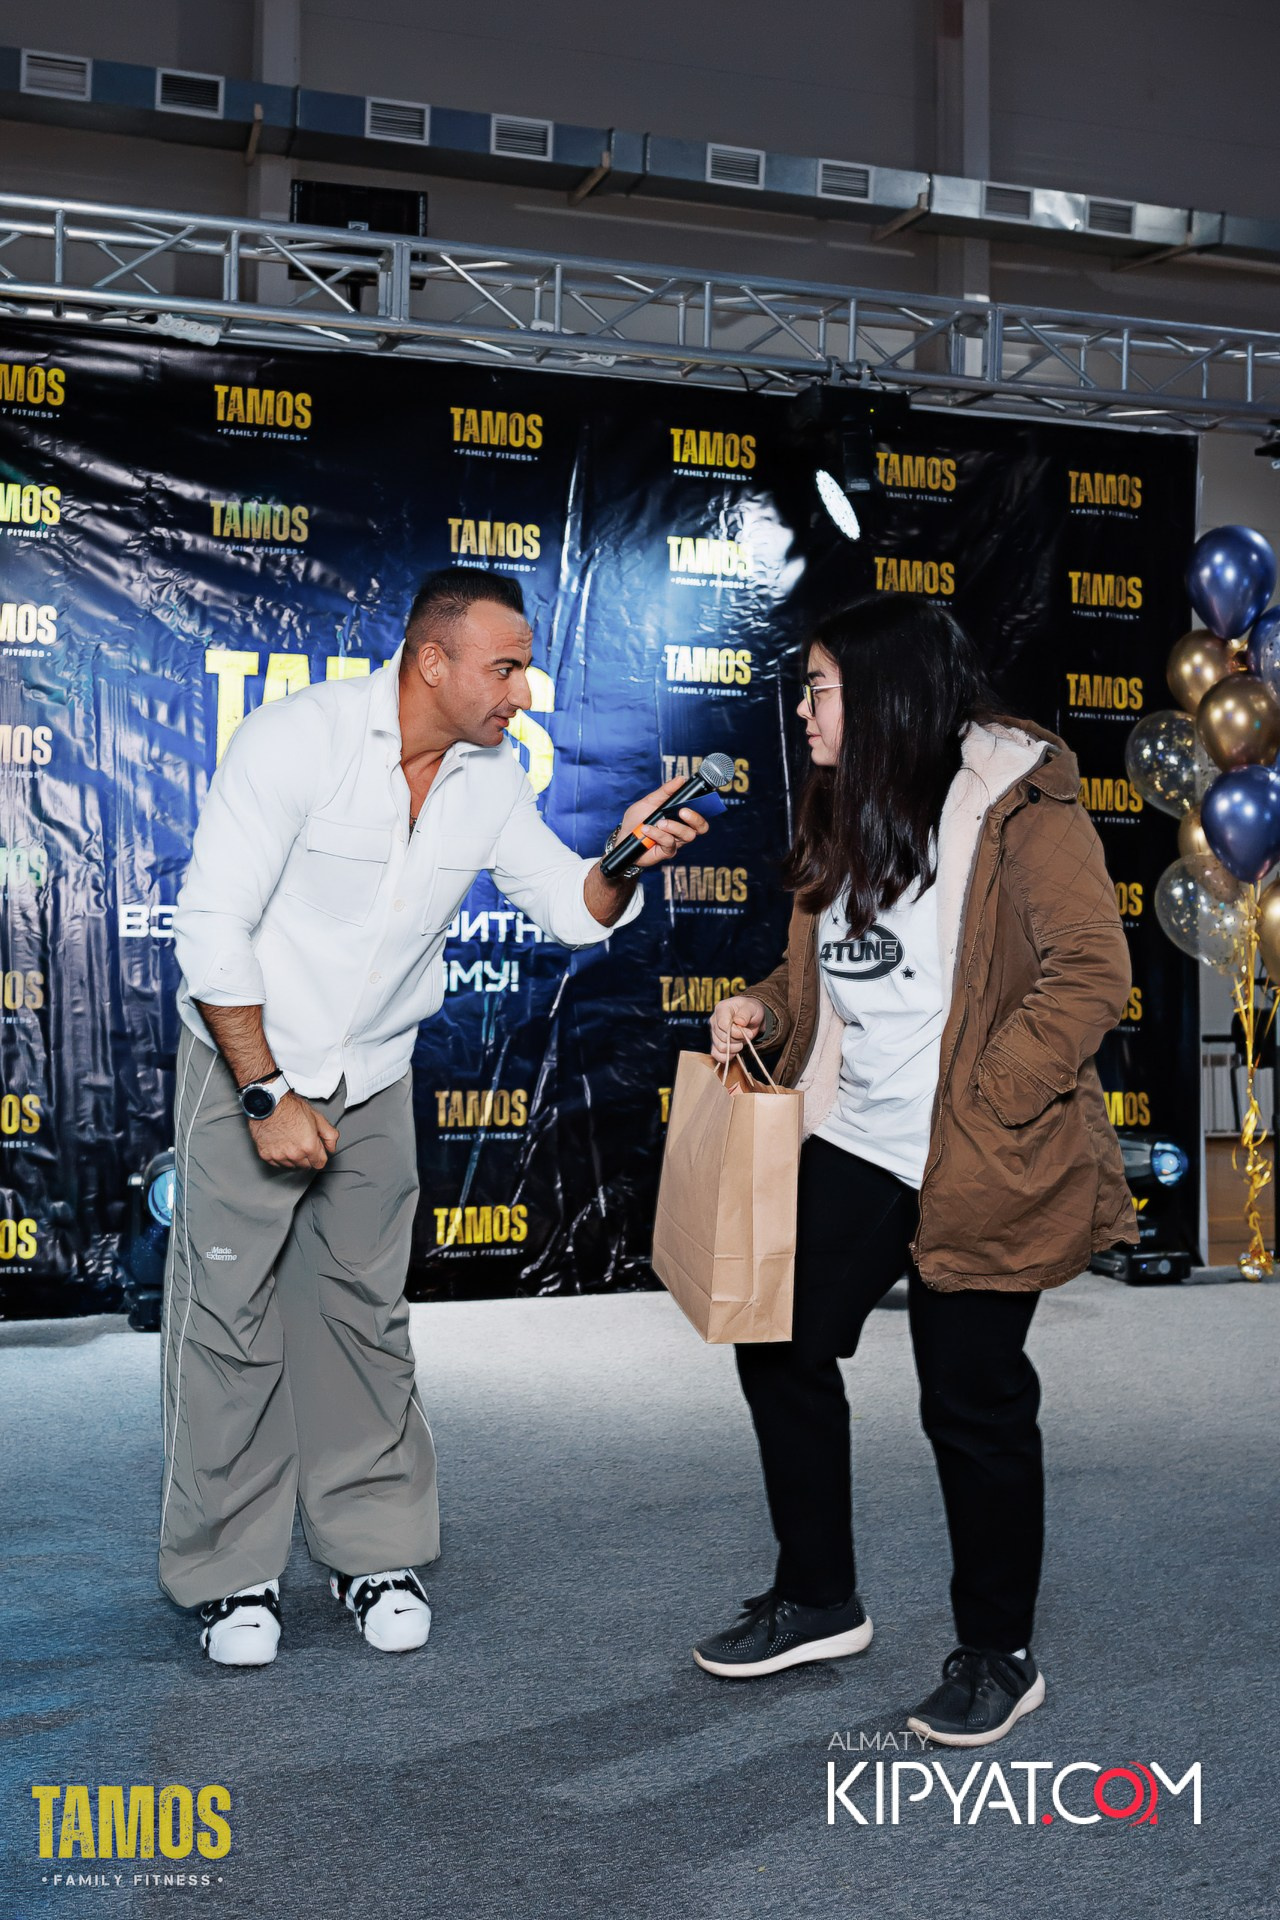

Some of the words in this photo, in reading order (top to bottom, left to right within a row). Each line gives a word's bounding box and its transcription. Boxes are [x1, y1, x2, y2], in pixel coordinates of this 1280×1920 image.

[0, 363, 66, 406] MOS
[12, 408, 53, 419] FITNESS
[213, 384, 312, 429] TAMOS
[223, 428, 258, 437] FAMILY
[262, 431, 302, 441] FITNESS
[450, 407, 543, 449] TAMOS
[459, 448, 493, 458] FAMILY
[495, 451, 533, 462] FITNESS
[670, 428, 756, 470] TAMOS
[678, 468, 710, 478] FAMILY
[712, 471, 747, 481] FITNESS
[876, 451, 957, 492] TAMOS
[1068, 470, 1142, 509] TAMOS
[0, 482, 61, 526] MOS
[210, 500, 309, 543] TAMOS
[447, 517, 541, 560] TAMOS
[667, 535, 754, 580] TAMOS
[457, 559, 490, 569] FAMILY
[493, 562, 531, 572] FITNESS
[874, 556, 955, 596] TAMOS
[1068, 571, 1143, 609] TAMOS
[0, 602, 57, 645] MOS
[664, 644, 752, 685] TAMOS
[672, 686, 705, 695] FAMILY
[707, 688, 743, 697] FITNESS
[1066, 673, 1143, 711] TAMOS
[662, 754, 749, 794] TAS
[1077, 777, 1143, 813] AMOS
[661, 865, 748, 903] TAMOS
[820, 940, 898, 963] 4TUNE
[435, 1089, 528, 1127] TAMOS
[1103, 1091, 1151, 1126] MOS
[433, 1204, 528, 1245] TAMOS
[443, 1250, 477, 1259] FAMILY
[480, 1247, 519, 1257] FITNESS
